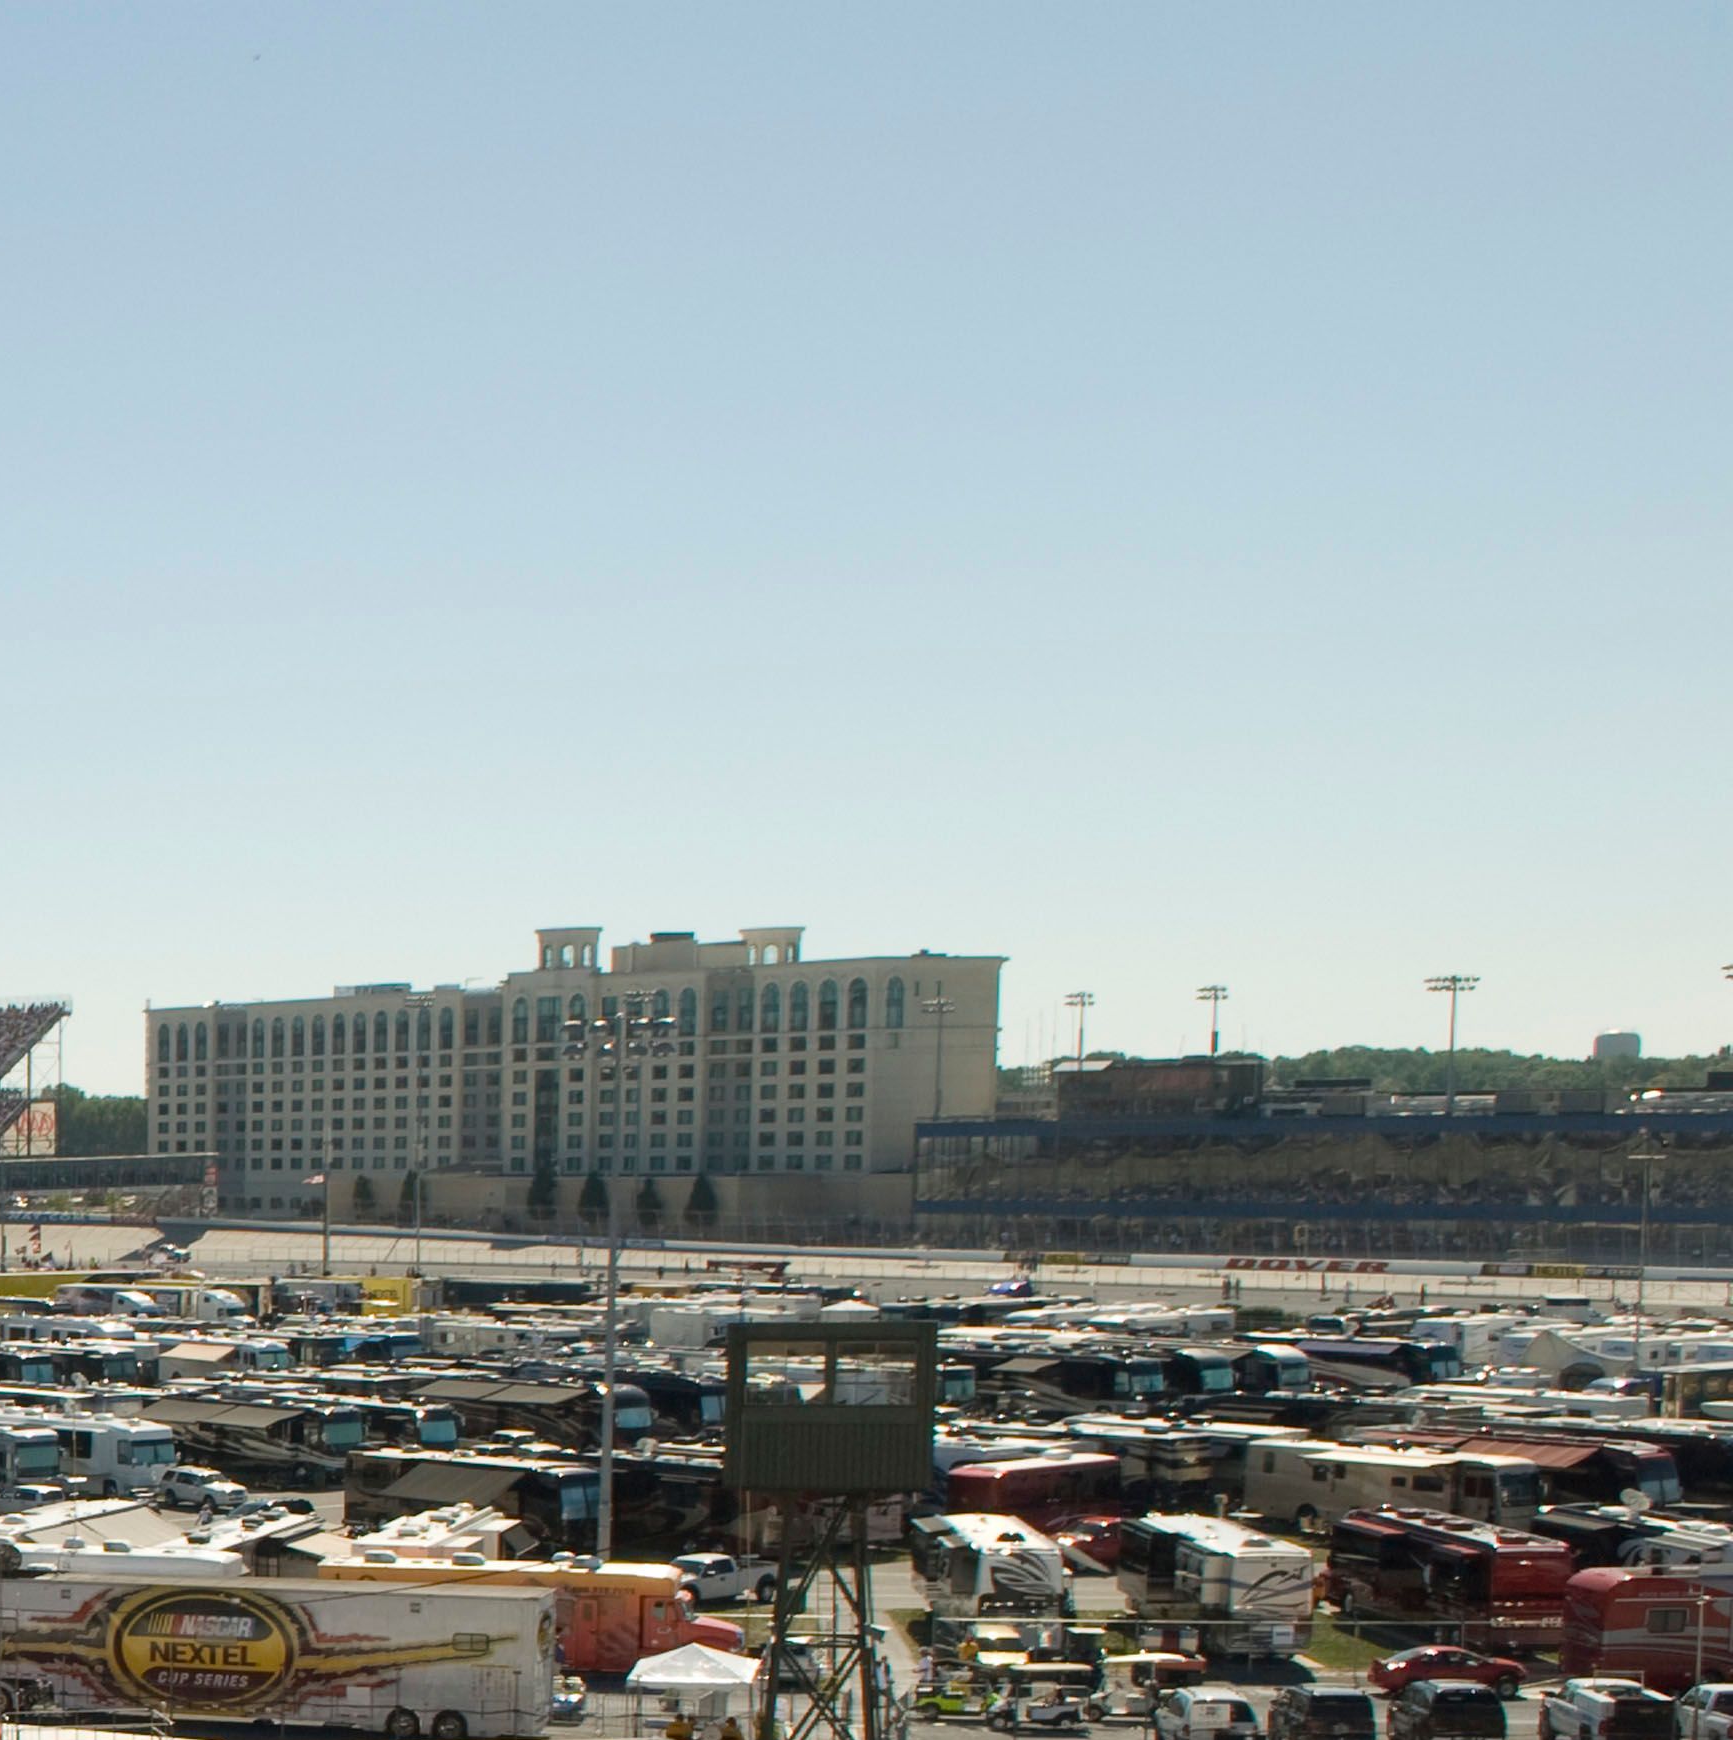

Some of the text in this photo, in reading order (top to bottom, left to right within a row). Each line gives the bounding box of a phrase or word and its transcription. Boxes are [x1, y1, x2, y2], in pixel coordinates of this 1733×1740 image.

[1224, 1258, 1390, 1273] DOVER
[179, 1613, 255, 1639] NASCAR
[149, 1641, 258, 1667] NEXTEL
[156, 1670, 250, 1689] CUP SERIES
